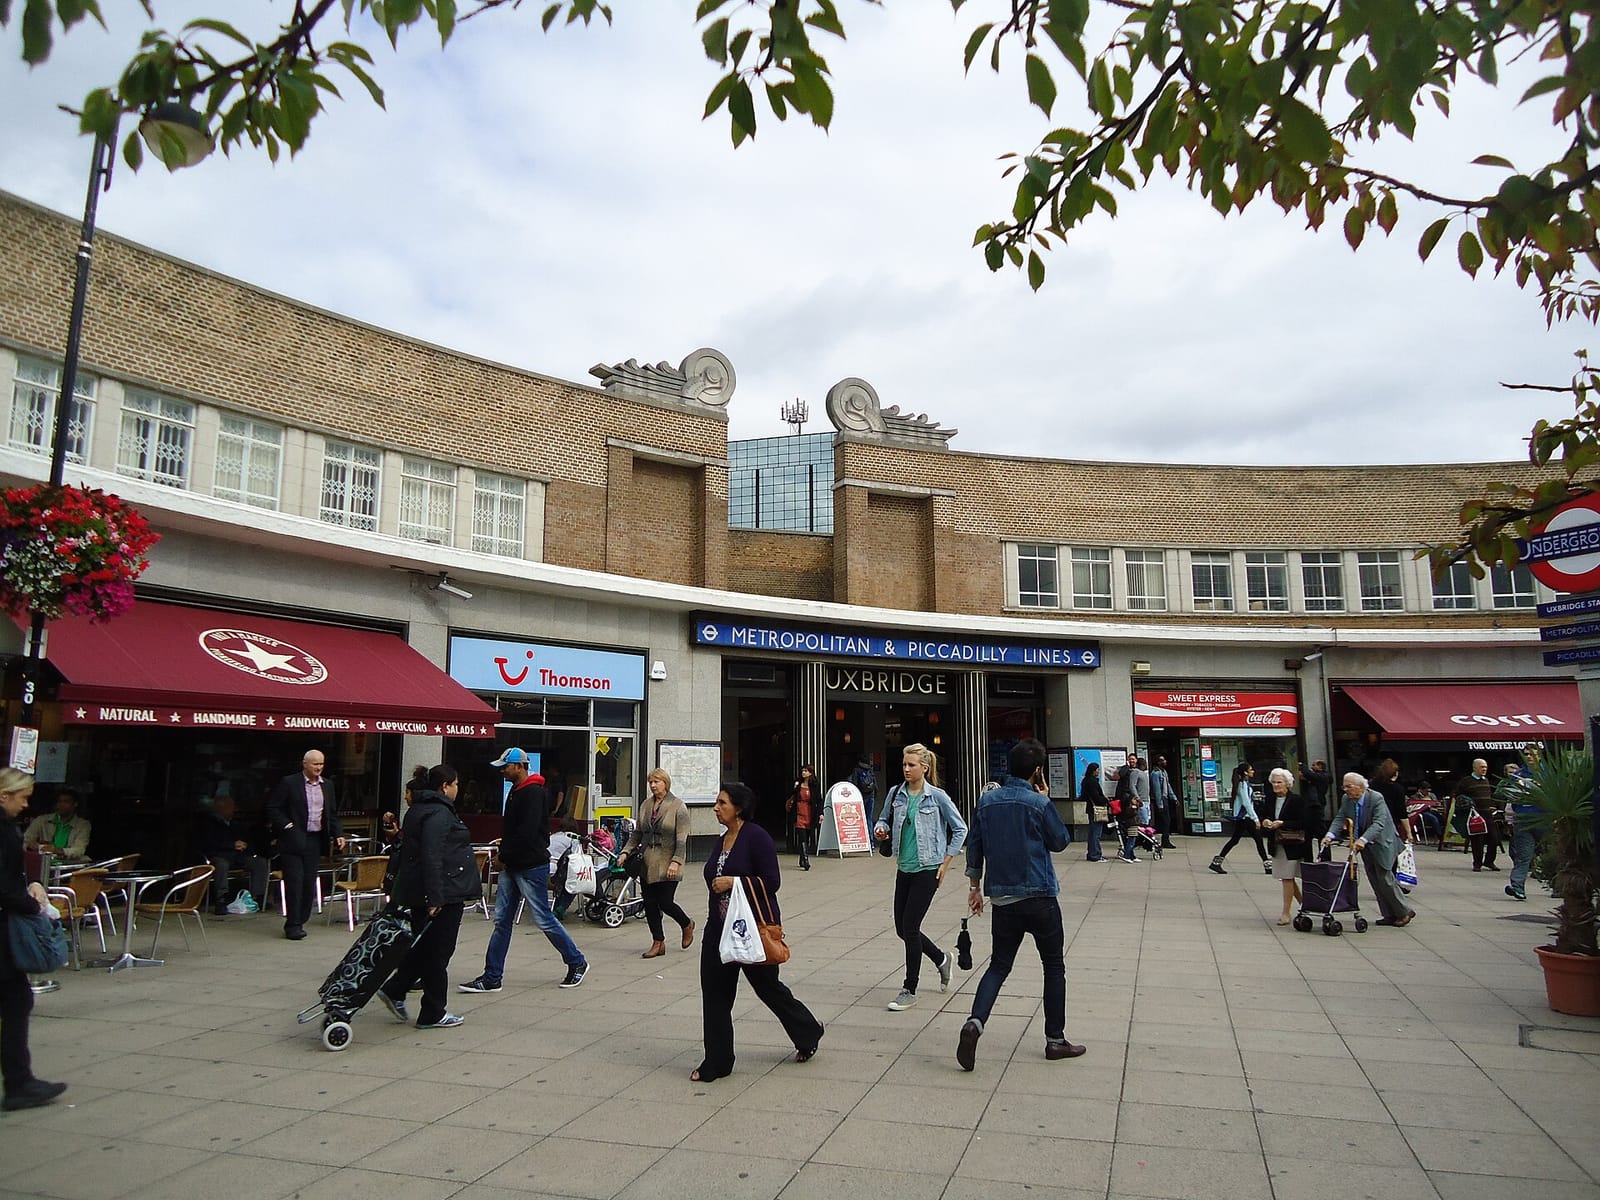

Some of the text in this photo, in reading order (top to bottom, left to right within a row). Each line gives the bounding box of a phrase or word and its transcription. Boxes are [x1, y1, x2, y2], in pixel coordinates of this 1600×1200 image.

[1546, 602, 1585, 613] UXBRIDGE
[1545, 624, 1600, 637] METROPOLITA
[732, 626, 1071, 664] METROPOLITAN & PICCADILLY LINES
[539, 668, 611, 690] Thomson
[826, 669, 948, 696] UXBRIDGE
[1167, 694, 1236, 703] SWEET EXPRESS
[99, 707, 475, 735] NATURAL HANDMADE SANDWICHES CAPPUCCINO SALADS
[1450, 714, 1566, 727] COSTA
[1468, 741, 1485, 750] FOR
[1485, 741, 1514, 750] COFFEE
